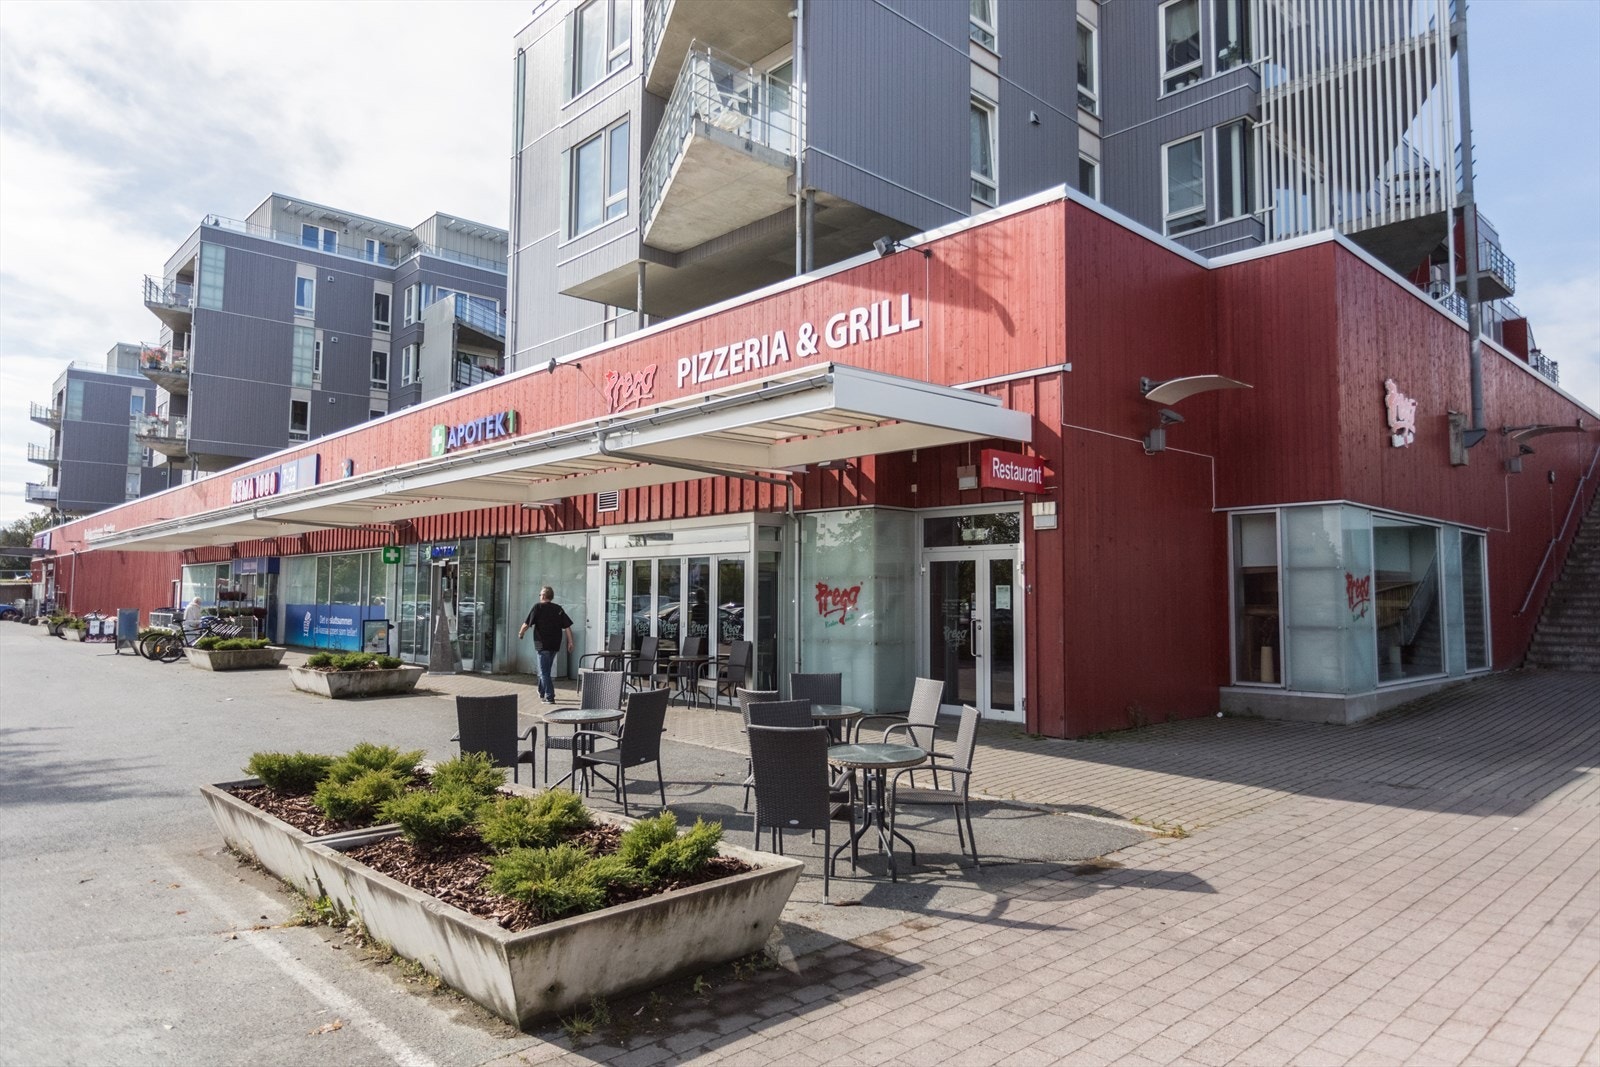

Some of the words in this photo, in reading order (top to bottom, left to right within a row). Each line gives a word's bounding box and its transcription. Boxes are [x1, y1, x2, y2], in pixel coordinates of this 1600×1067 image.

[677, 331, 790, 388] PIZZERIA
[796, 323, 819, 357] &
[825, 293, 920, 349] GRILL
[604, 364, 657, 414] Prego
[447, 412, 506, 448] APOTEK
[231, 477, 253, 503] REMA
[255, 472, 275, 498] 1000
[992, 457, 1042, 484] Restaurant
[815, 581, 861, 625] Prego
